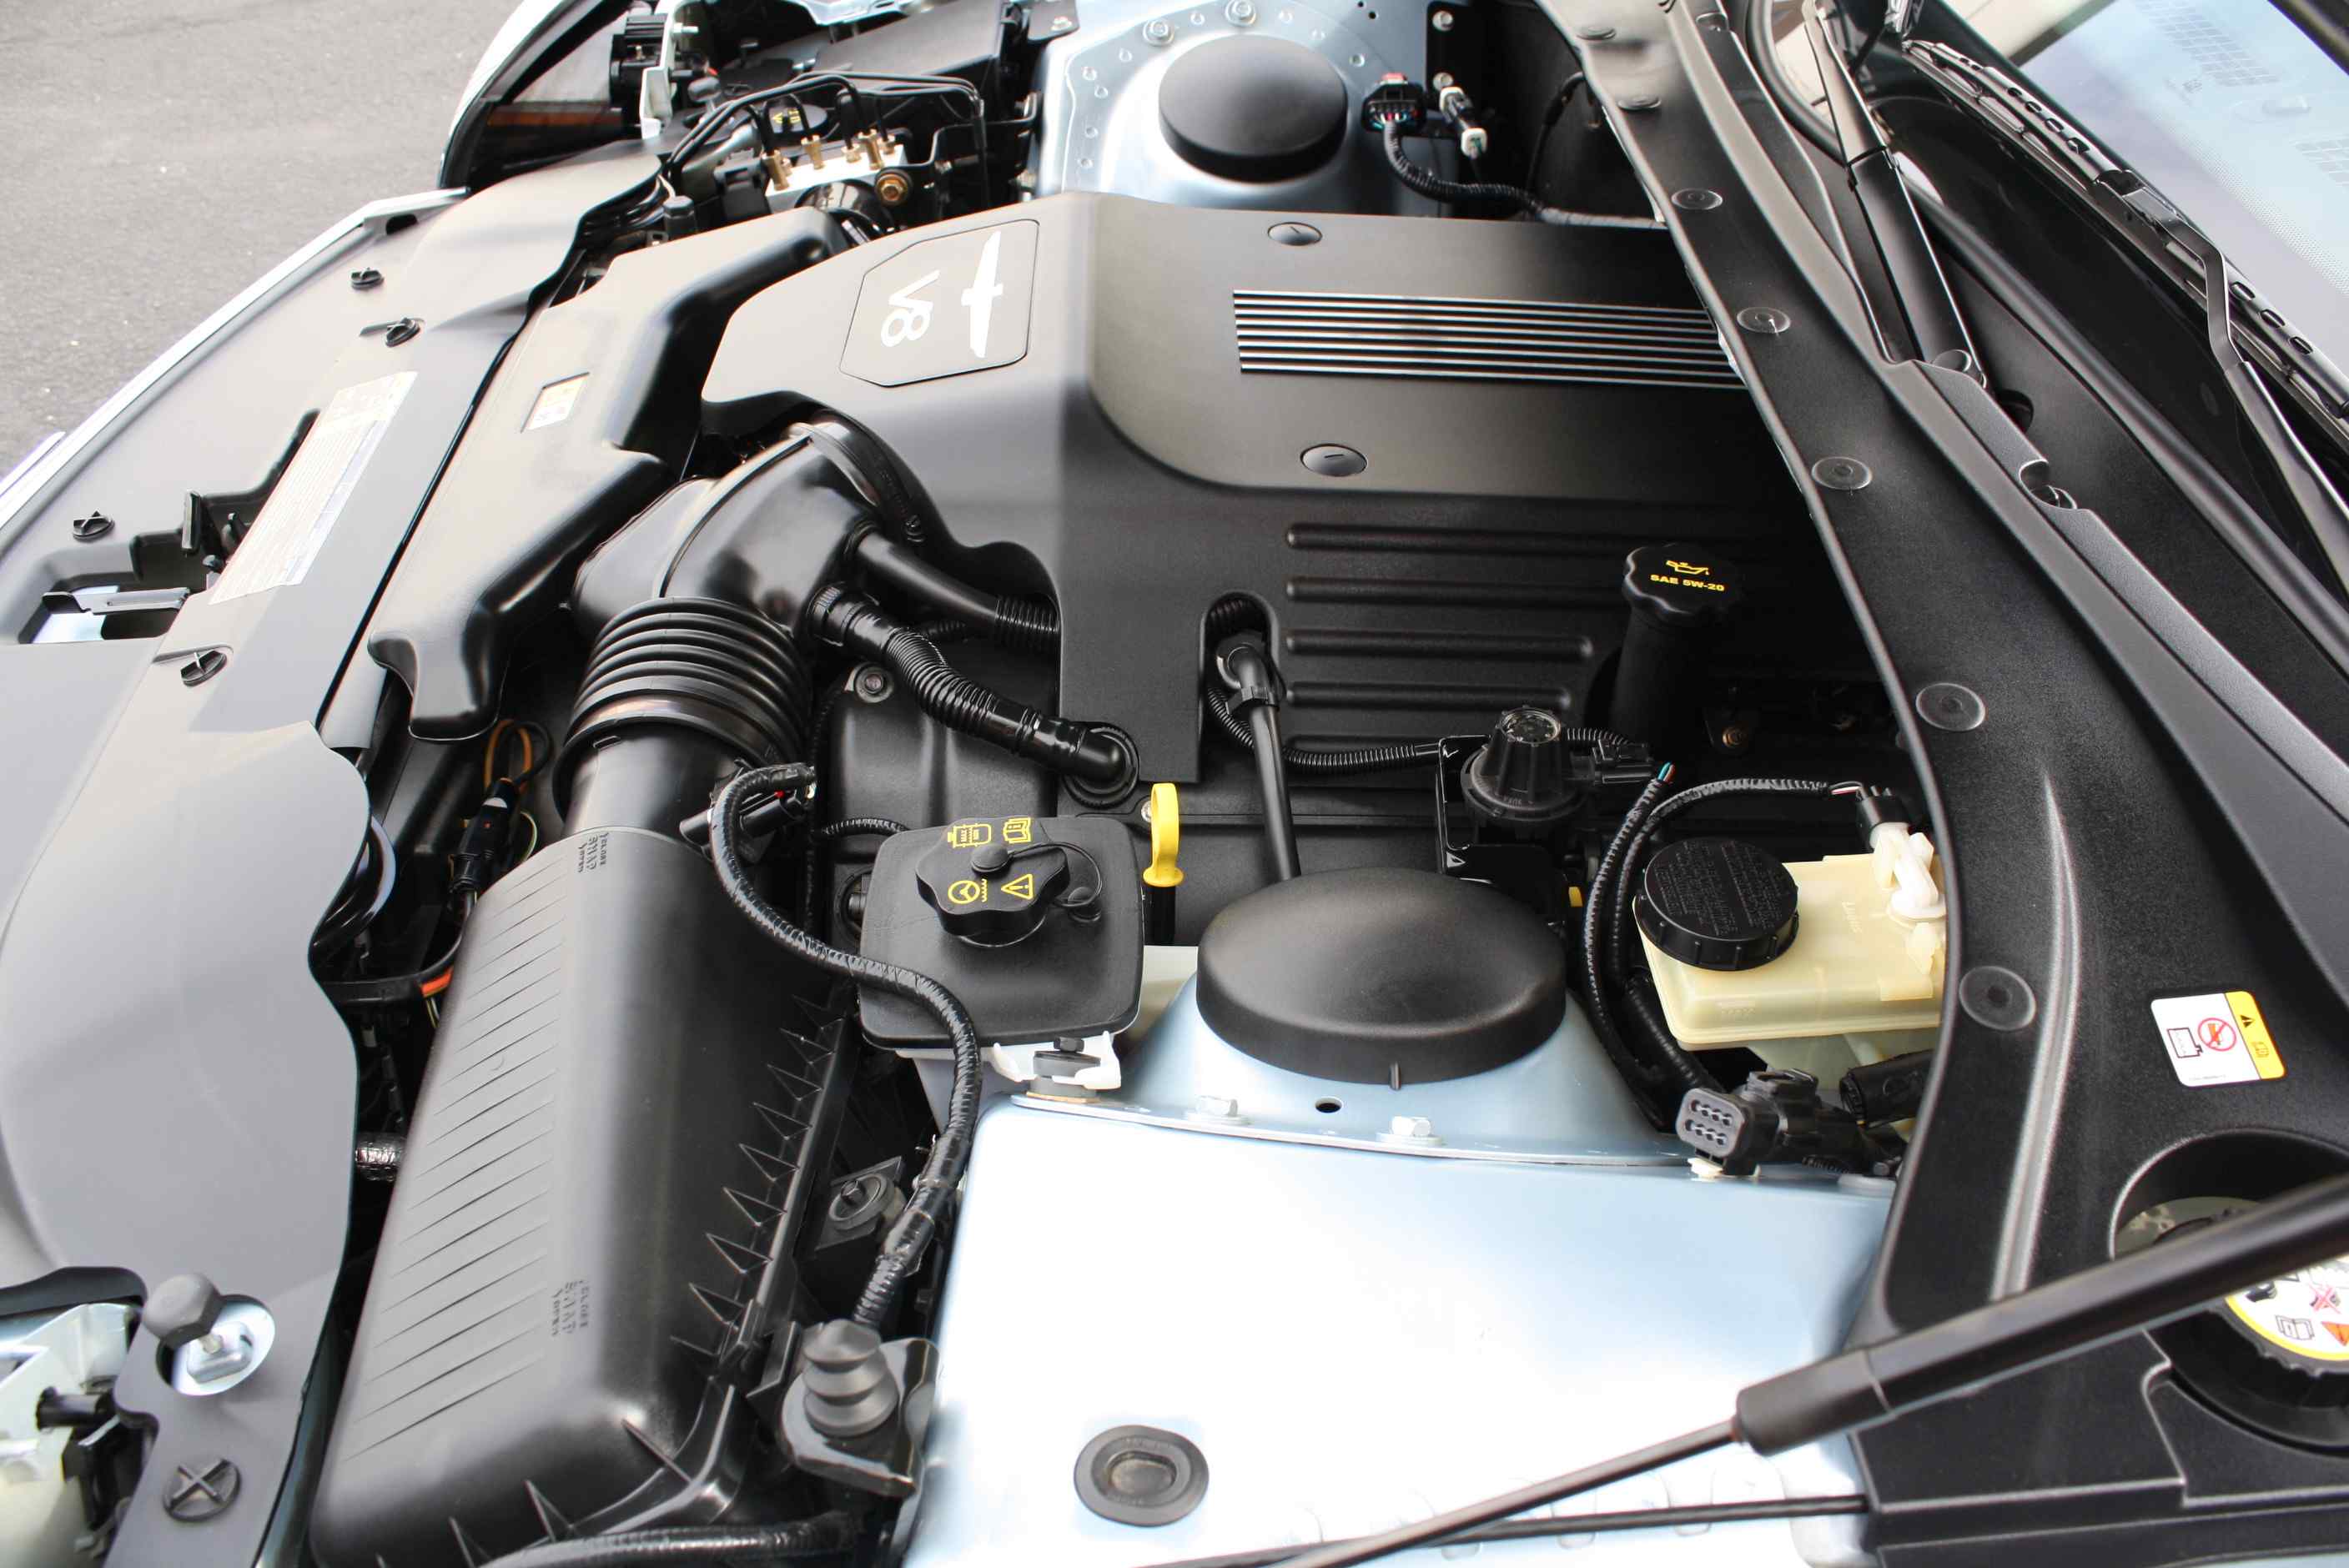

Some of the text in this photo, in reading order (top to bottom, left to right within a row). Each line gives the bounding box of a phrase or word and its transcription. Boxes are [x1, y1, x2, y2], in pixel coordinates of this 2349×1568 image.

[880, 269, 942, 348] V8
[1650, 574, 1725, 592] SAE 5W-20
